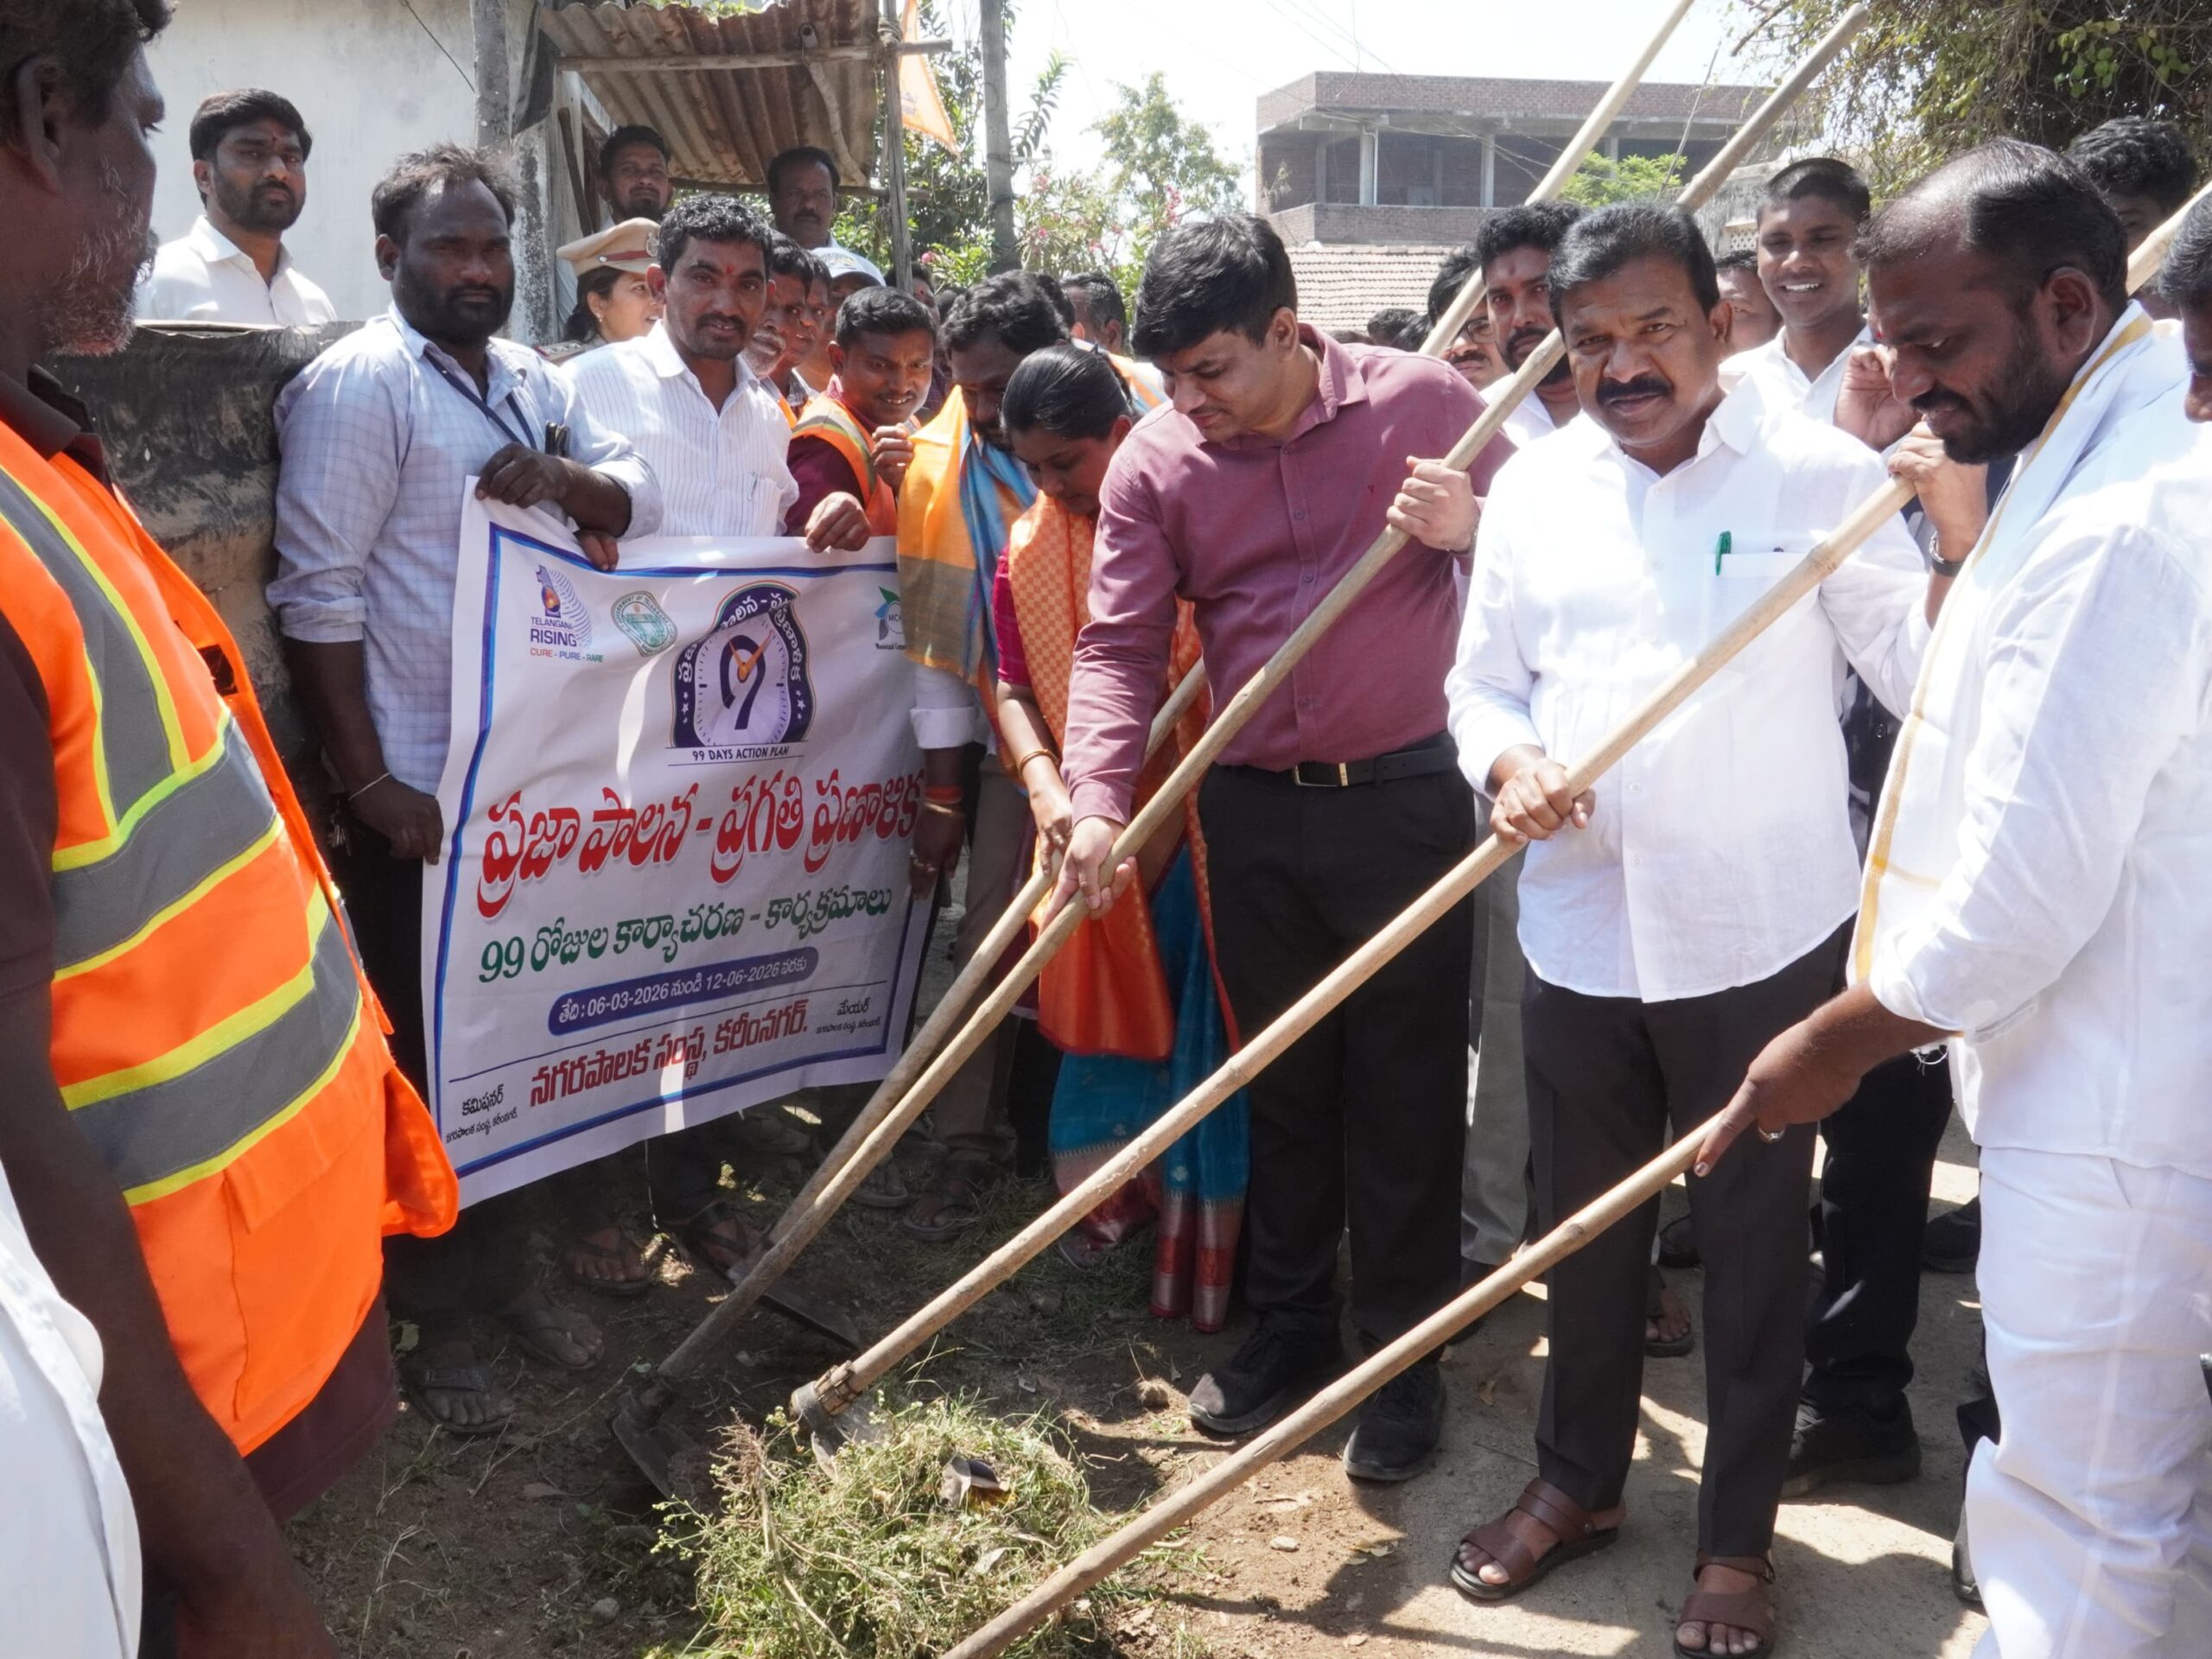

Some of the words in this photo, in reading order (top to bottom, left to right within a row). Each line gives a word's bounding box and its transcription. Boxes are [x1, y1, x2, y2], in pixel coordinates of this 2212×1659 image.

[530, 628, 577, 647] RISING
[531, 616, 574, 630] TELANGANA
[530, 647, 553, 658] CURE
[559, 650, 582, 660] PURE
[586, 654, 604, 663] RARE
[692, 750, 705, 761] 99
[709, 747, 734, 760] DAYS
[736, 746, 767, 758] ACTION
[769, 745, 790, 757] PLAN
[477, 789, 582, 918] ప్రజా
[578, 782, 700, 874] పాలన
[710, 768, 804, 884] ప్రగతి
[804, 767, 925, 874] ప్రణాళిక
[479, 936, 525, 983] 99
[530, 916, 609, 972] రోజుల
[613, 901, 745, 963] కార్యాచరణ
[765, 884, 893, 940] కార్యక్రమాలు
[587, 982, 670, 1017] 06-03-2026
[670, 971, 703, 997] నుండి
[706, 962, 779, 991] 12-06-2026
[530, 1037, 652, 1108] నగరపాలక
[461, 1083, 505, 1116] కమిషనర్
